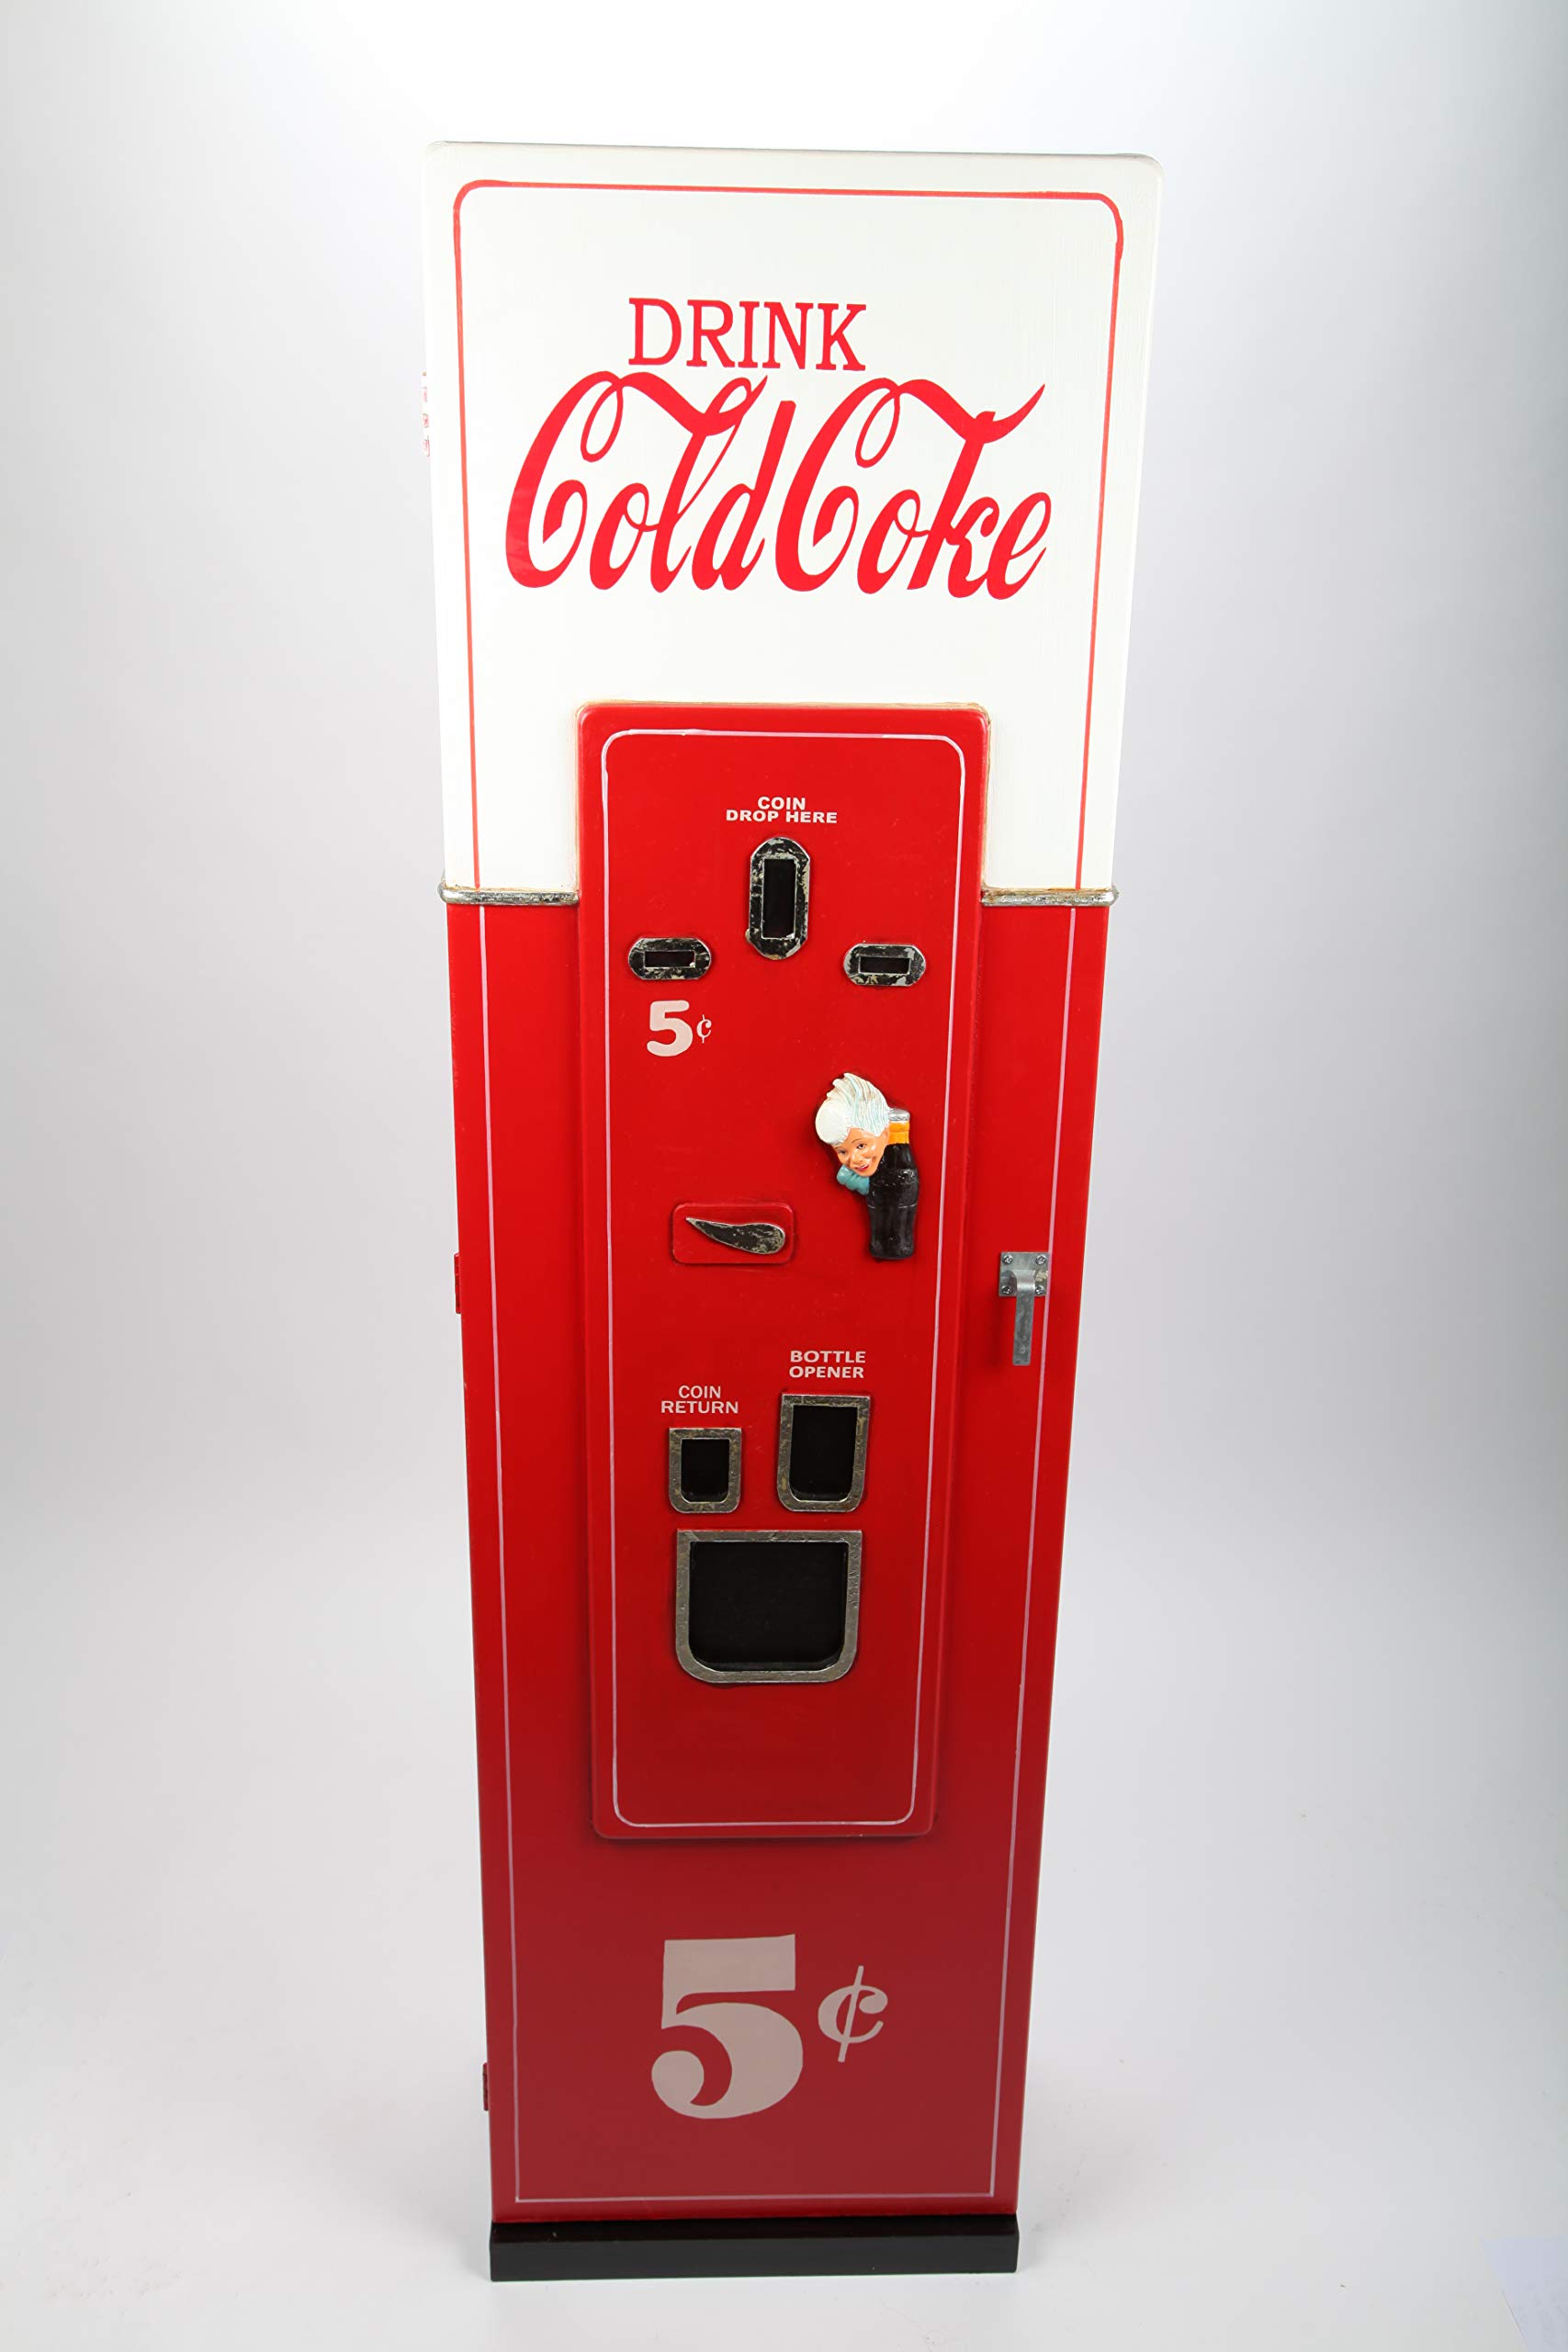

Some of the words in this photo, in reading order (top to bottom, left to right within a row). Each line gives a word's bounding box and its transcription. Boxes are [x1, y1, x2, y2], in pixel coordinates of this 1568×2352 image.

[628, 297, 867, 371] DRINK
[757, 796, 806, 810] COIN
[726, 809, 779, 822] DROP
[785, 810, 838, 824] HERE
[790, 1350, 866, 1363] BOTTLE
[788, 1365, 864, 1379] OPENER
[678, 1385, 721, 1399] COIN
[660, 1400, 739, 1414] RETURN
